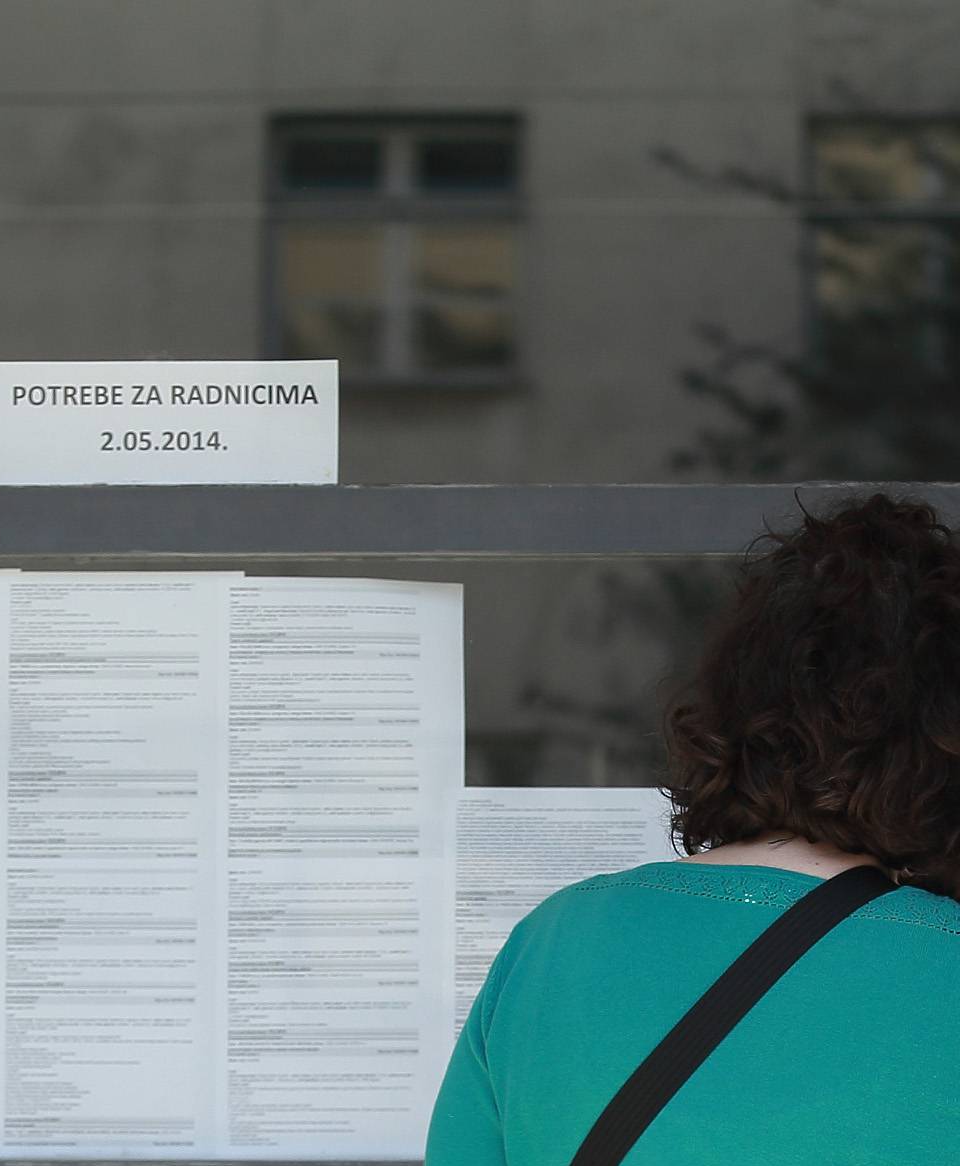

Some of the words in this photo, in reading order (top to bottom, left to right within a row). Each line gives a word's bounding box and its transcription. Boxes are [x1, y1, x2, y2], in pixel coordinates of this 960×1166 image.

[12, 385, 123, 405] POTREBE
[131, 385, 163, 405] ZA
[171, 384, 319, 405] RADNICIMA
[100, 431, 228, 451] 2.05.2014.
